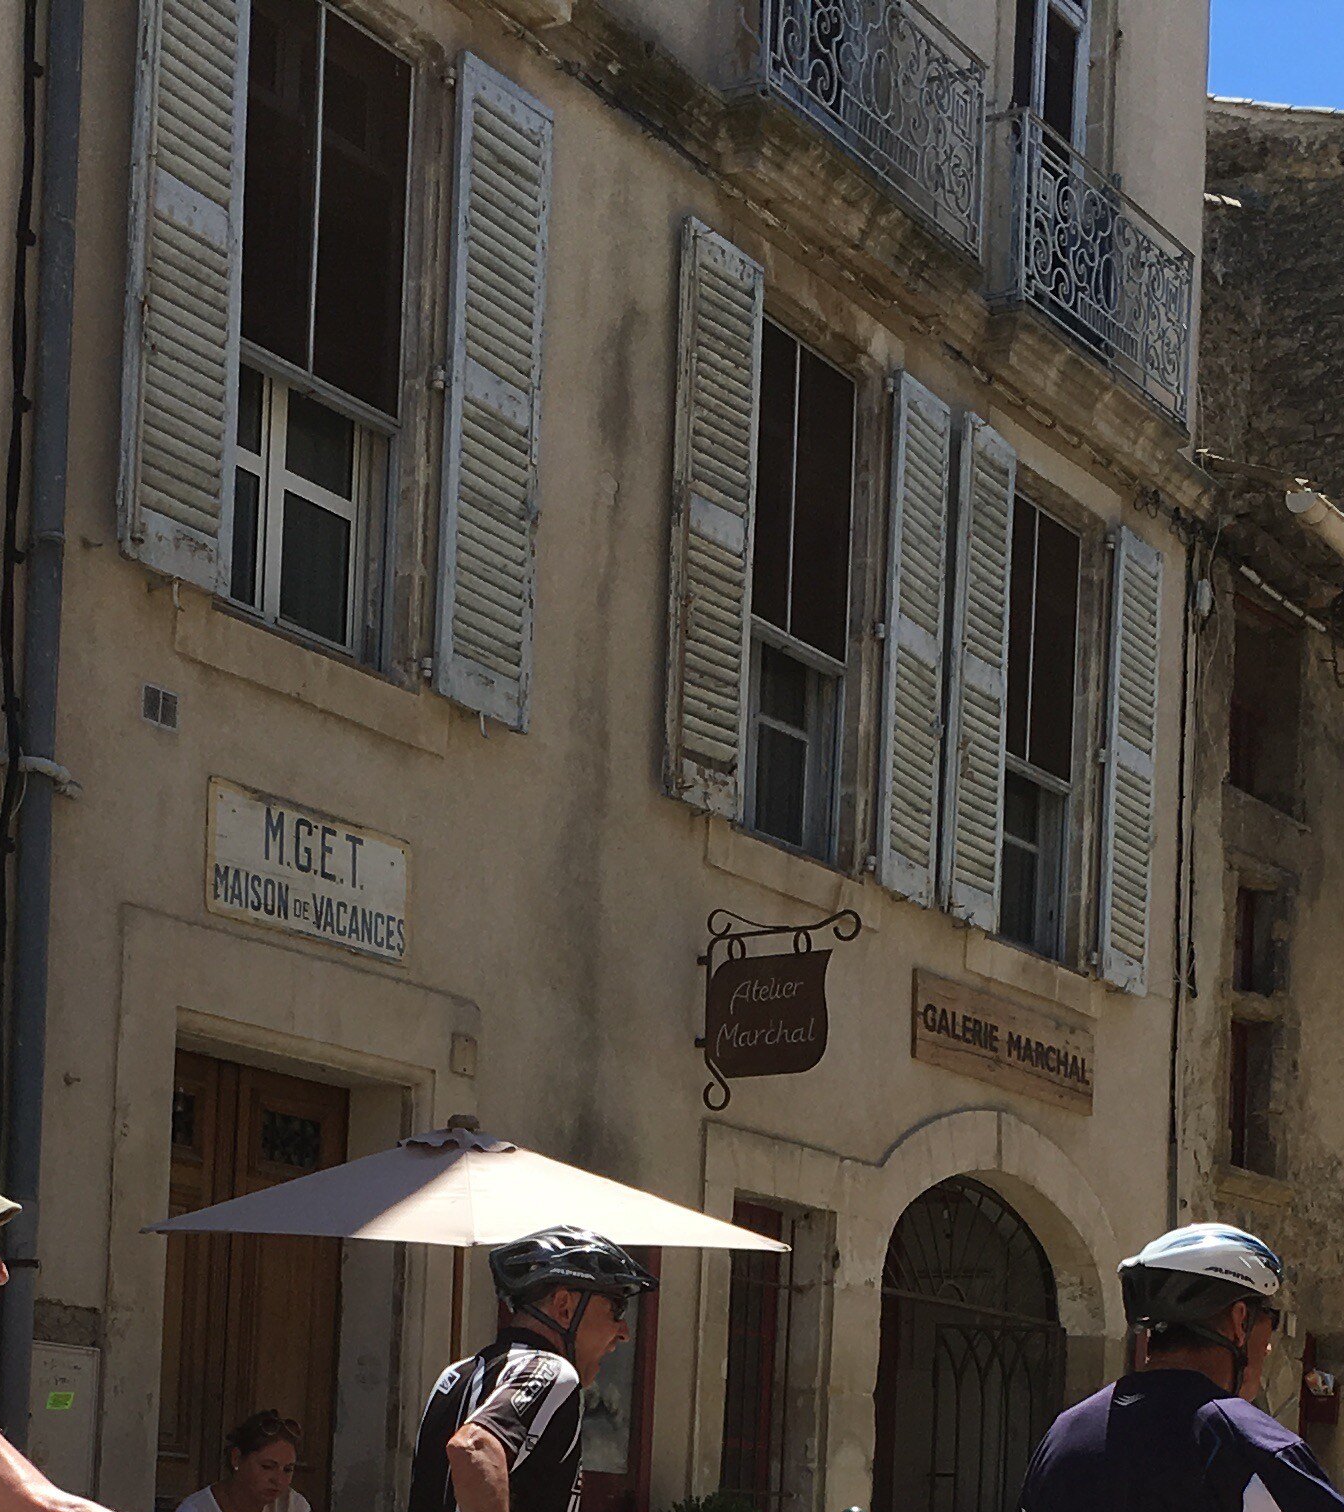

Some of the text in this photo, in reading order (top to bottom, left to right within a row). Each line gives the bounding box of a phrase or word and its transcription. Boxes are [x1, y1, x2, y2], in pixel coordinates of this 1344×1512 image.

[264, 806, 365, 891] M.G.E.T.
[214, 862, 405, 957] MAISON DE VACANCES
[729, 977, 804, 1015] Atelier
[716, 1019, 816, 1058] Marchal
[922, 1003, 1090, 1087] GALERIE MARCHAL
